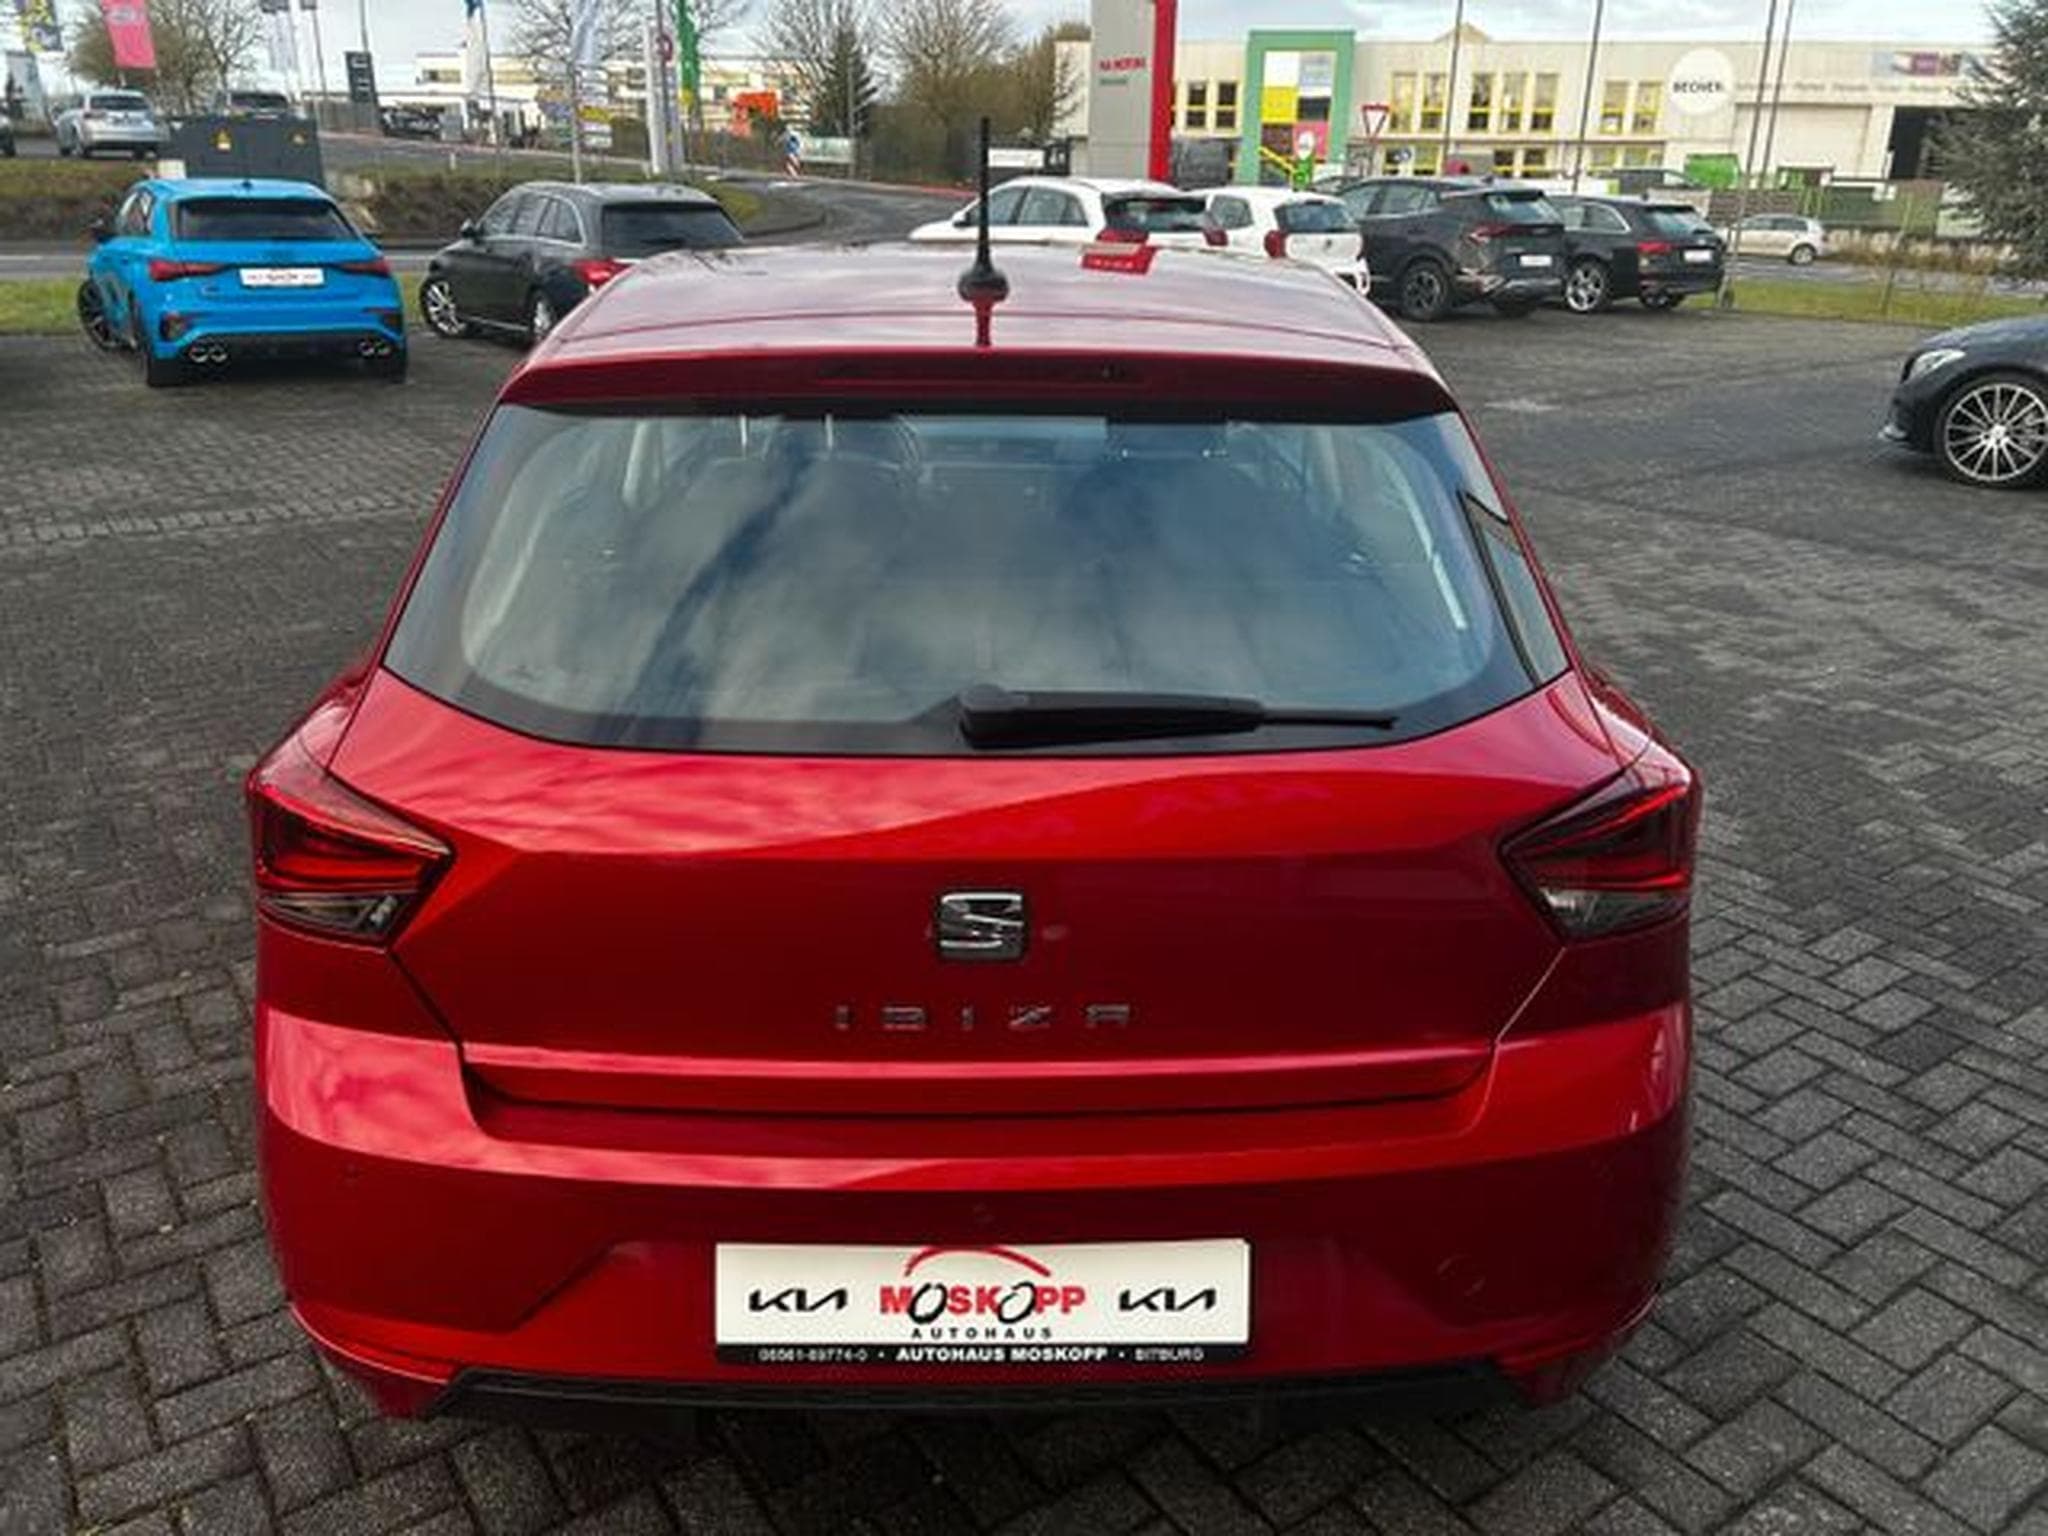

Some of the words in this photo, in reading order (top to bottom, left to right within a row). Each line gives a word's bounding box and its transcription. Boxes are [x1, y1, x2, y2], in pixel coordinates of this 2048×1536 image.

[880, 1282, 1086, 1324] MOSKOPP
[911, 1326, 1052, 1340] AUTOHAUS
[895, 1347, 1005, 1362] AUTOHAUS
[1010, 1347, 1108, 1362] MOSKOPP
